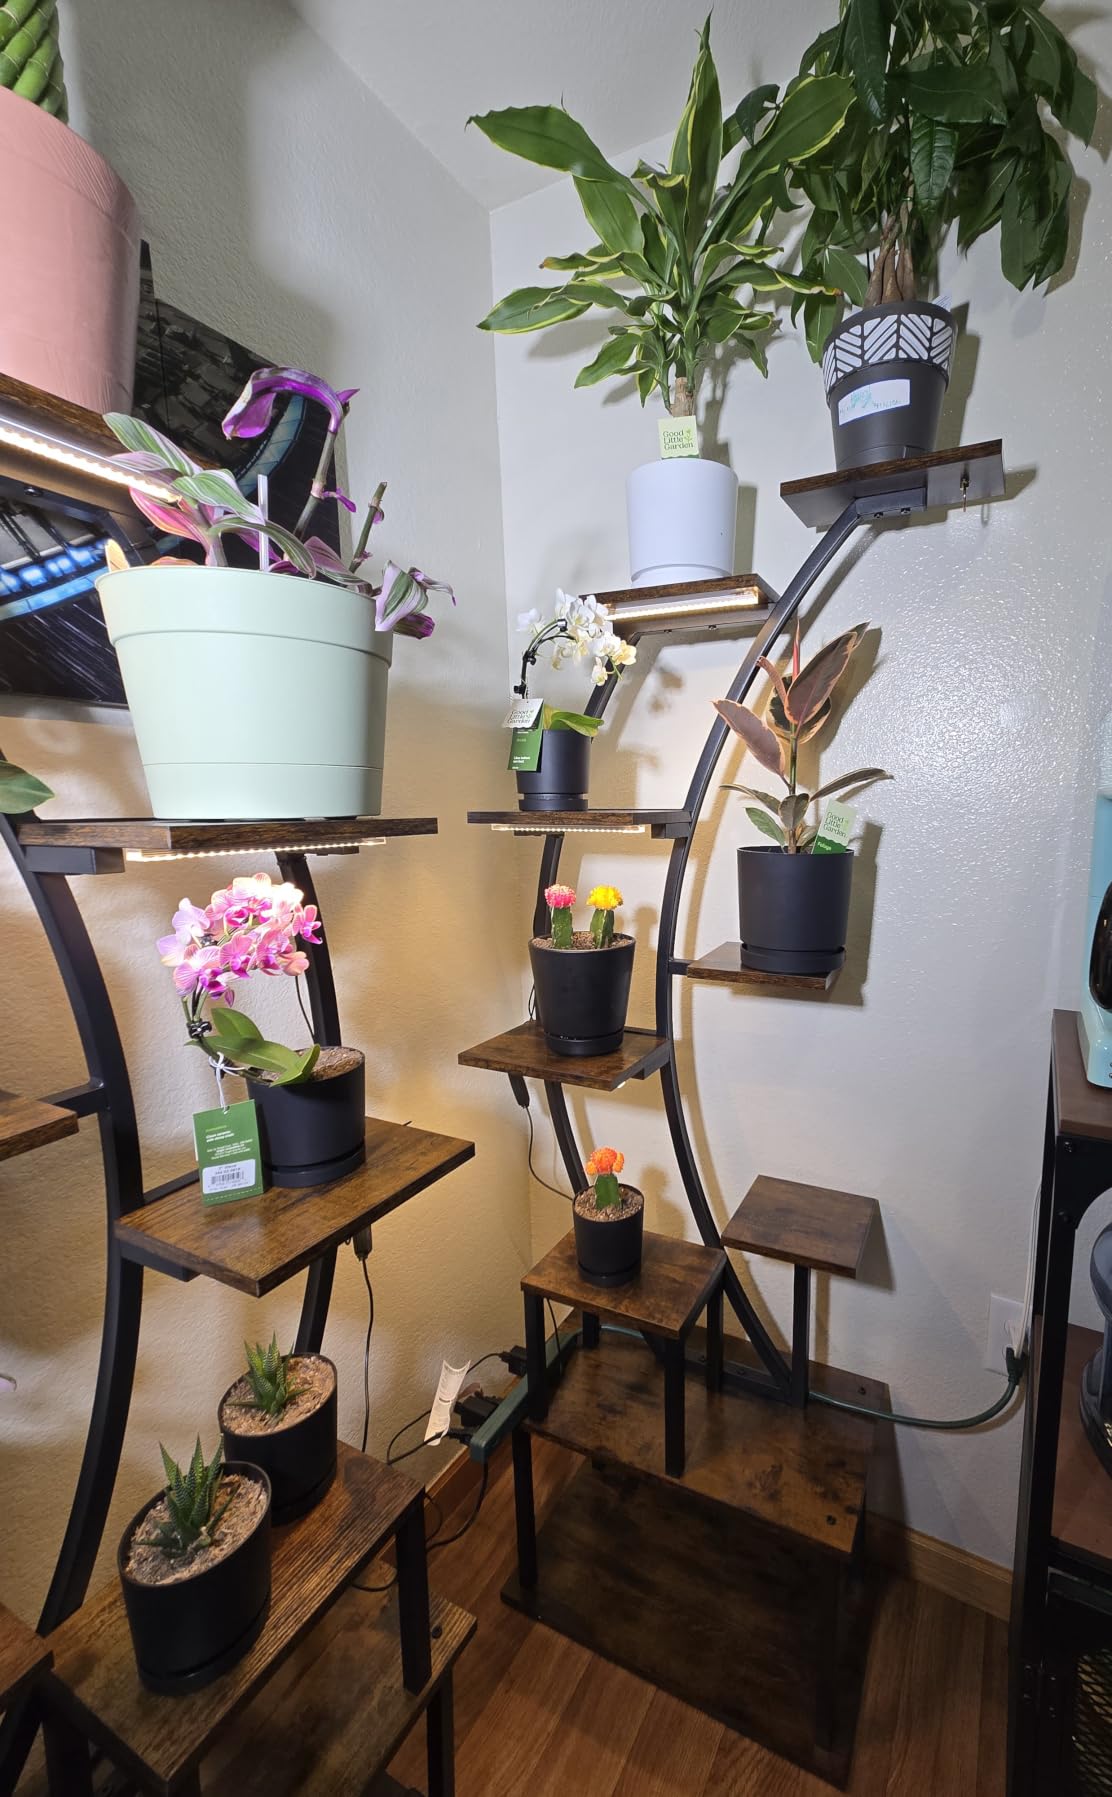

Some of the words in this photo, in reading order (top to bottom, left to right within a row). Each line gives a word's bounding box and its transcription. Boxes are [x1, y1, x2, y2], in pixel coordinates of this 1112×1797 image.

[662, 430, 684, 438] Good
[664, 442, 694, 451] Garden
[827, 811, 845, 824] Good
[825, 817, 841, 829] Little
